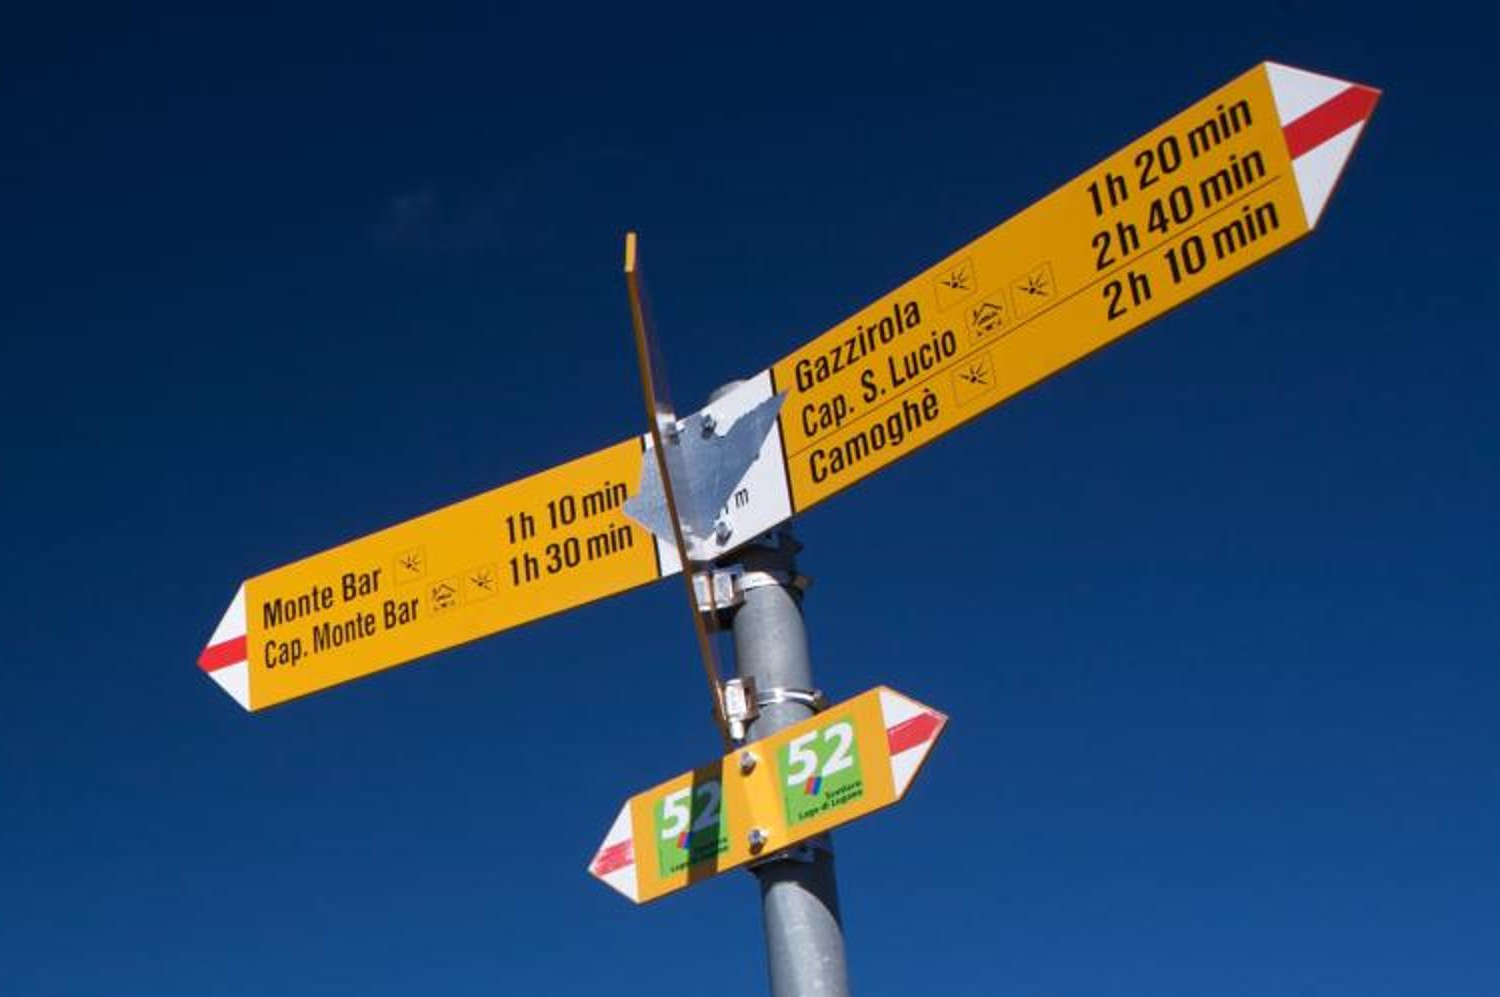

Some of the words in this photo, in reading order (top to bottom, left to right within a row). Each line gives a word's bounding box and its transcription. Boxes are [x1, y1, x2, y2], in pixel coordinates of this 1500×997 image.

[794, 301, 921, 393] Gazzirola
[1087, 172, 1129, 217] 1h
[1134, 135, 1183, 191] 20
[1187, 99, 1253, 159] min
[801, 393, 855, 438] Cap.
[860, 369, 887, 404] S.
[888, 329, 957, 388] Lucio
[1091, 221, 1141, 272] 2h
[1147, 185, 1195, 234] 40
[1199, 150, 1266, 209] min
[809, 388, 939, 484] Camoghè
[1103, 271, 1152, 321] 2h
[1164, 235, 1207, 284] 10
[1212, 201, 1280, 260] min
[263, 585, 333, 629] Monte
[341, 568, 381, 602] Bar
[506, 511, 535, 544] 1h
[547, 495, 577, 529] 10
[582, 480, 629, 518] min
[265, 639, 309, 669] Cap.
[313, 612, 375, 652] Monte
[383, 598, 419, 630] Bar
[510, 552, 540, 586] 1h
[545, 537, 581, 574] 30
[586, 523, 633, 561] min
[661, 781, 721, 840] 52
[787, 721, 853, 785] 52
